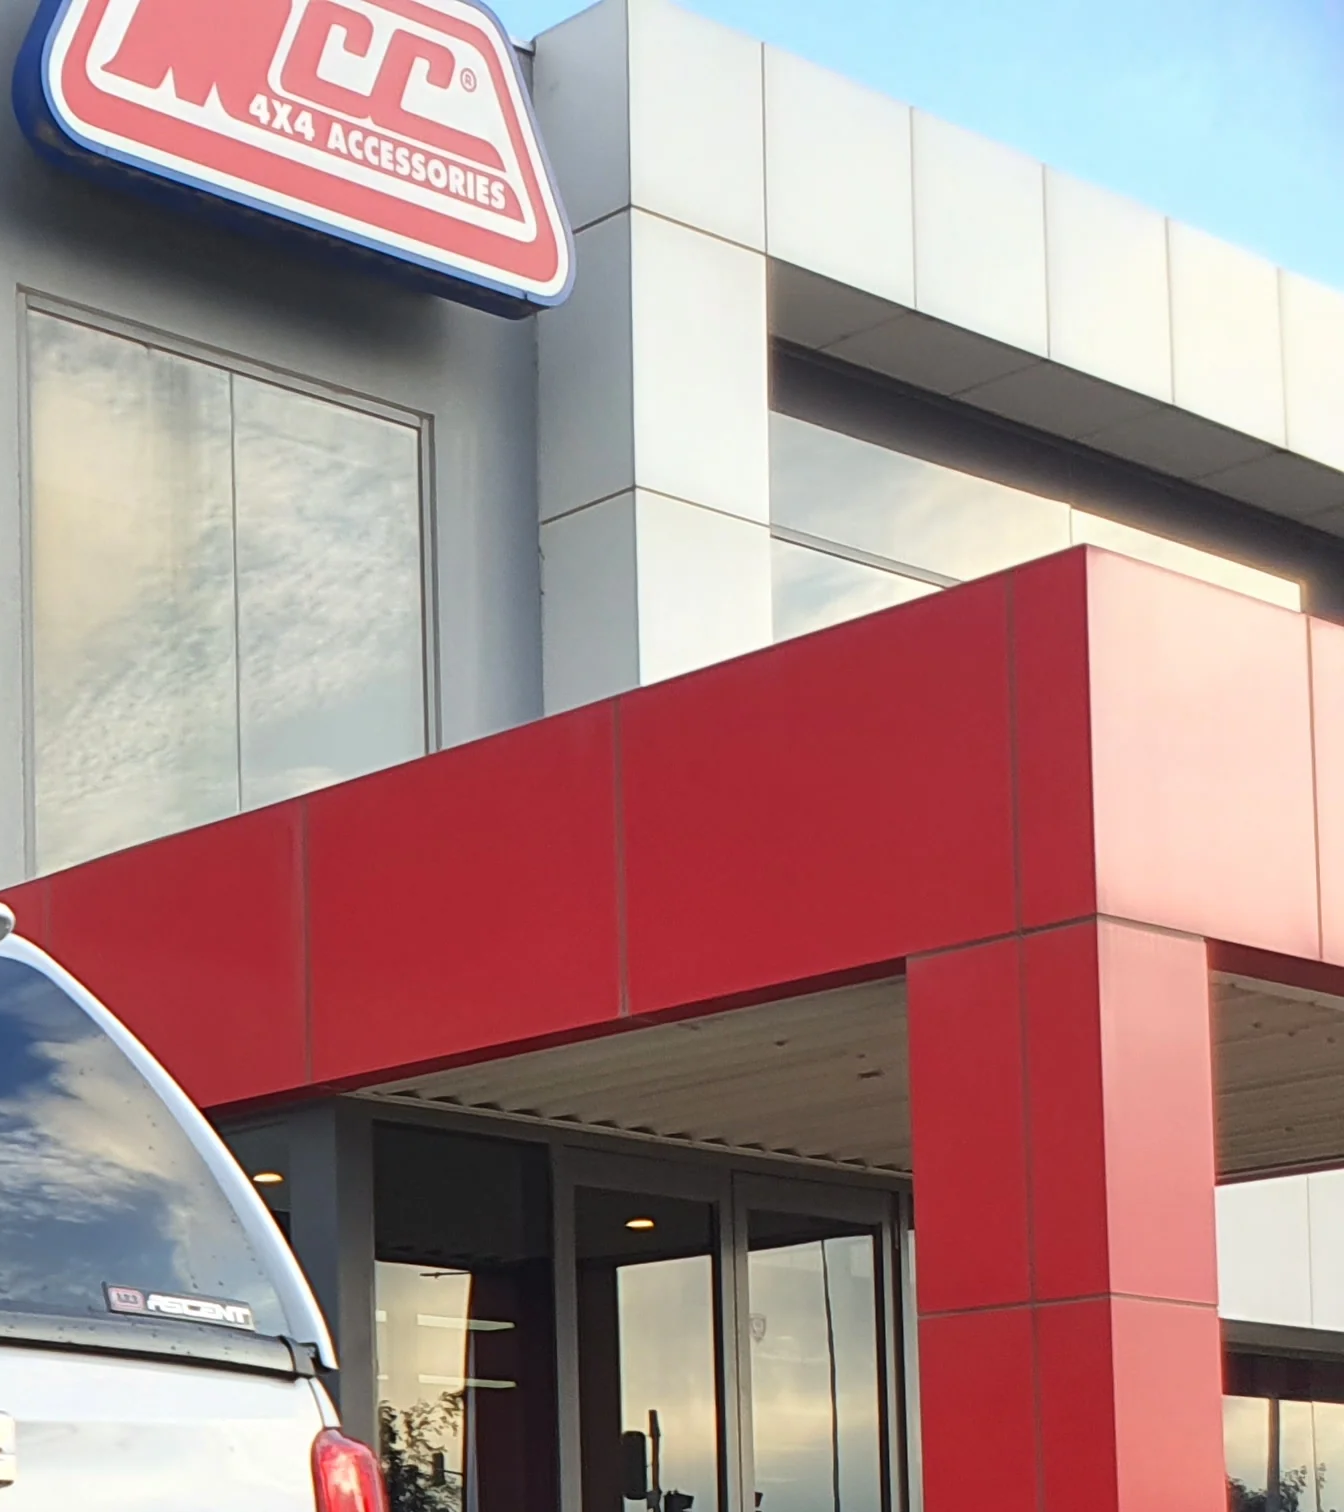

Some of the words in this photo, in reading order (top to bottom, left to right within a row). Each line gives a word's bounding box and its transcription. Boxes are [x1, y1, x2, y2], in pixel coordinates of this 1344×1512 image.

[248, 93, 315, 142] 4X4
[327, 122, 507, 210] ACCESSORIES
[146, 1293, 252, 1324] ASCENT
